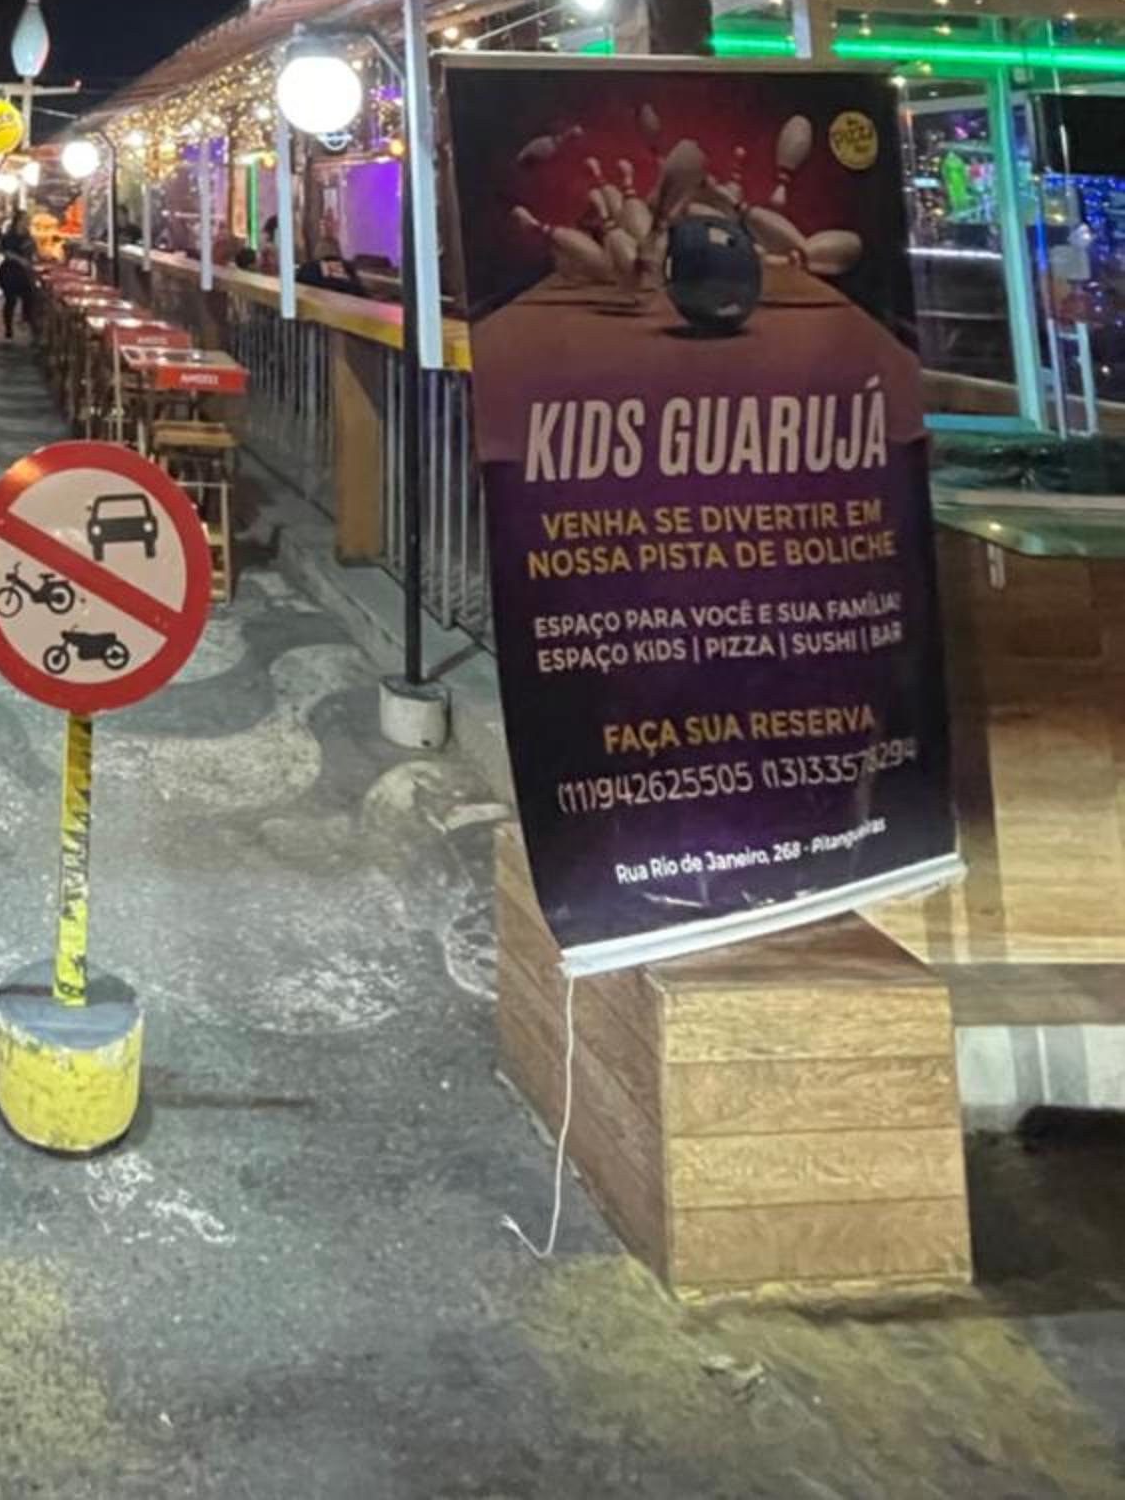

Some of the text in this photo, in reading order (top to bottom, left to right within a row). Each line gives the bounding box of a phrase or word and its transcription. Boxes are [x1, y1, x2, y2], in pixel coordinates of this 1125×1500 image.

[525, 376, 888, 482] KIDS GUARUJÁ
[542, 498, 882, 541] VENHA SE DIVERTIR EM
[528, 529, 898, 579] NOSSA PISTA DE BOLICHE
[534, 610, 621, 640] ESPAÇO
[625, 606, 686, 633] PARA
[690, 597, 754, 628] VOCÊ
[759, 604, 773, 624] E
[778, 601, 823, 622] SUA
[538, 641, 628, 674] ESPAÇO
[705, 631, 775, 660] PIZZA
[792, 629, 858, 655] SUSHI
[871, 620, 901, 649] BAR
[603, 705, 874, 757] FAÇA SUA RESERVA
[615, 861, 649, 885] Rua
[650, 854, 679, 879] Rio
[680, 853, 704, 874] de
[772, 840, 802, 864] 268
